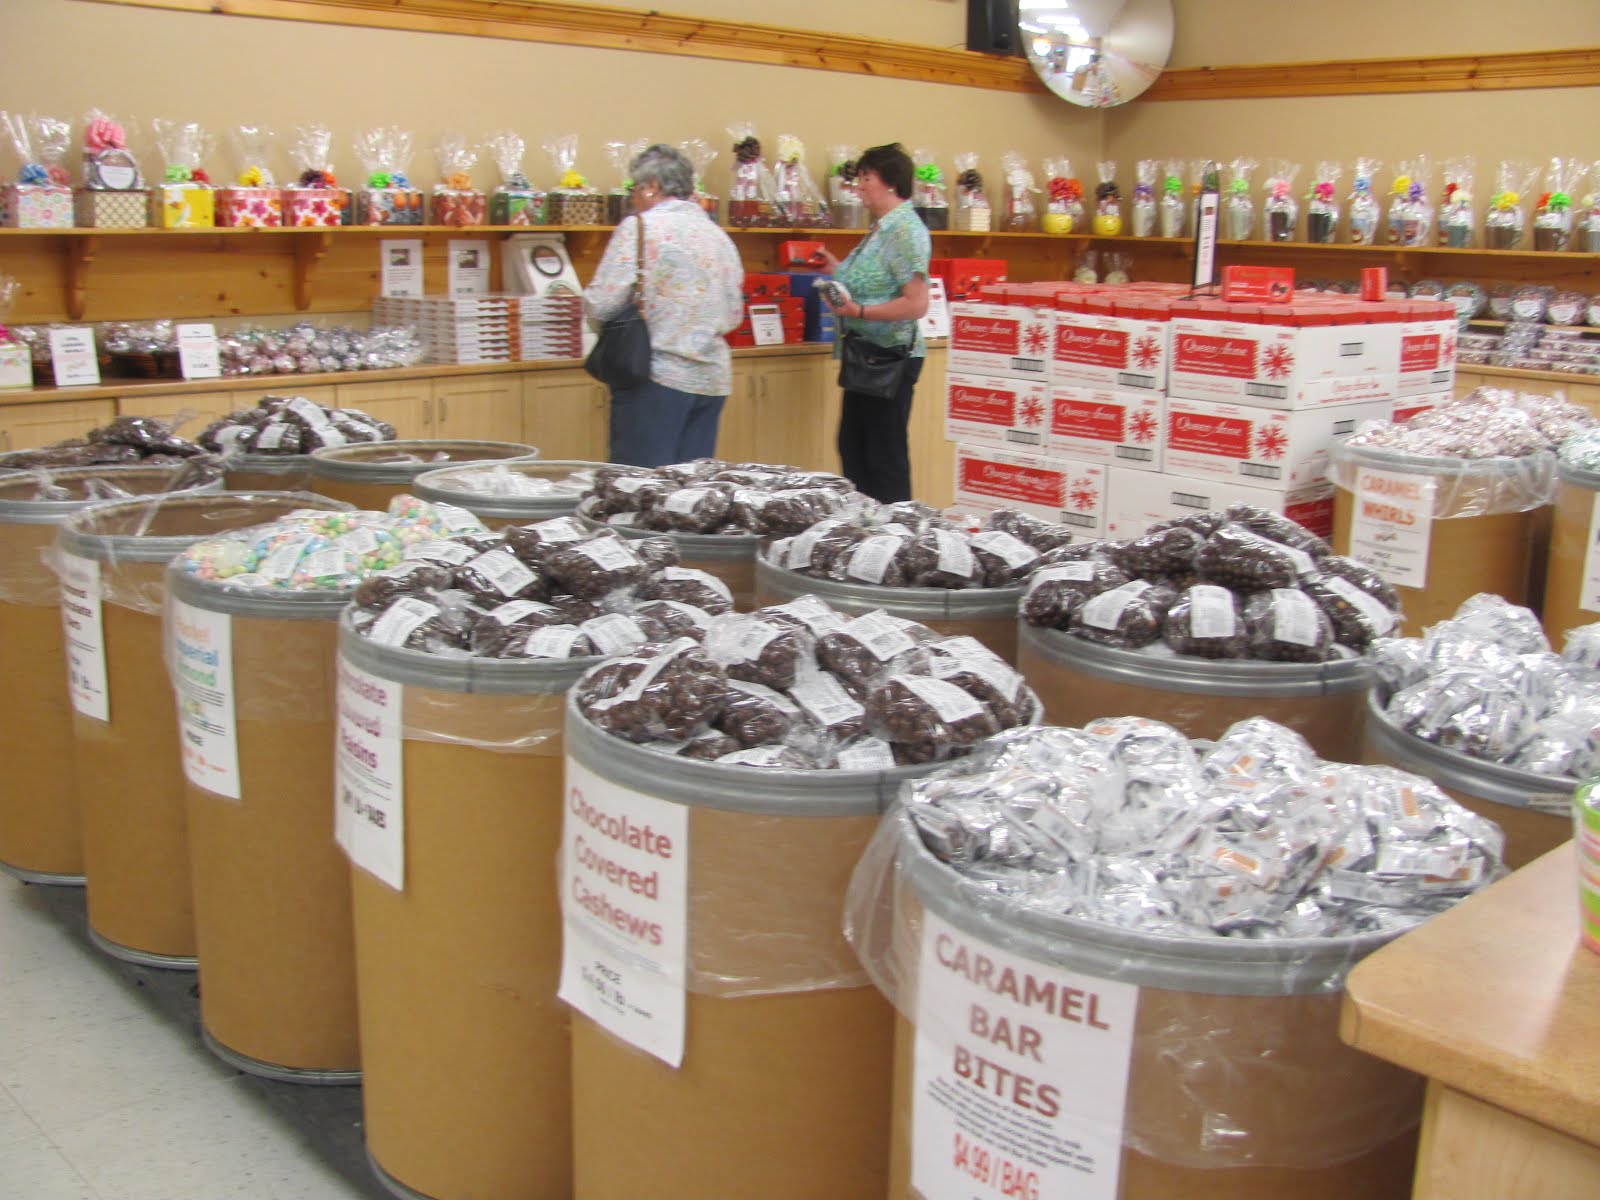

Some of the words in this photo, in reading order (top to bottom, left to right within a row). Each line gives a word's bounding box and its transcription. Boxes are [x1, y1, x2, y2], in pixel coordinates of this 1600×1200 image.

[1361, 474, 1422, 501] CARAMEL
[569, 785, 673, 859] Chocolate
[574, 834, 659, 900] Covered
[571, 875, 663, 946] Cashews
[935, 933, 1110, 1031] CARAMEL
[969, 1003, 1043, 1063] BAR
[953, 1045, 1061, 1118] BITES
